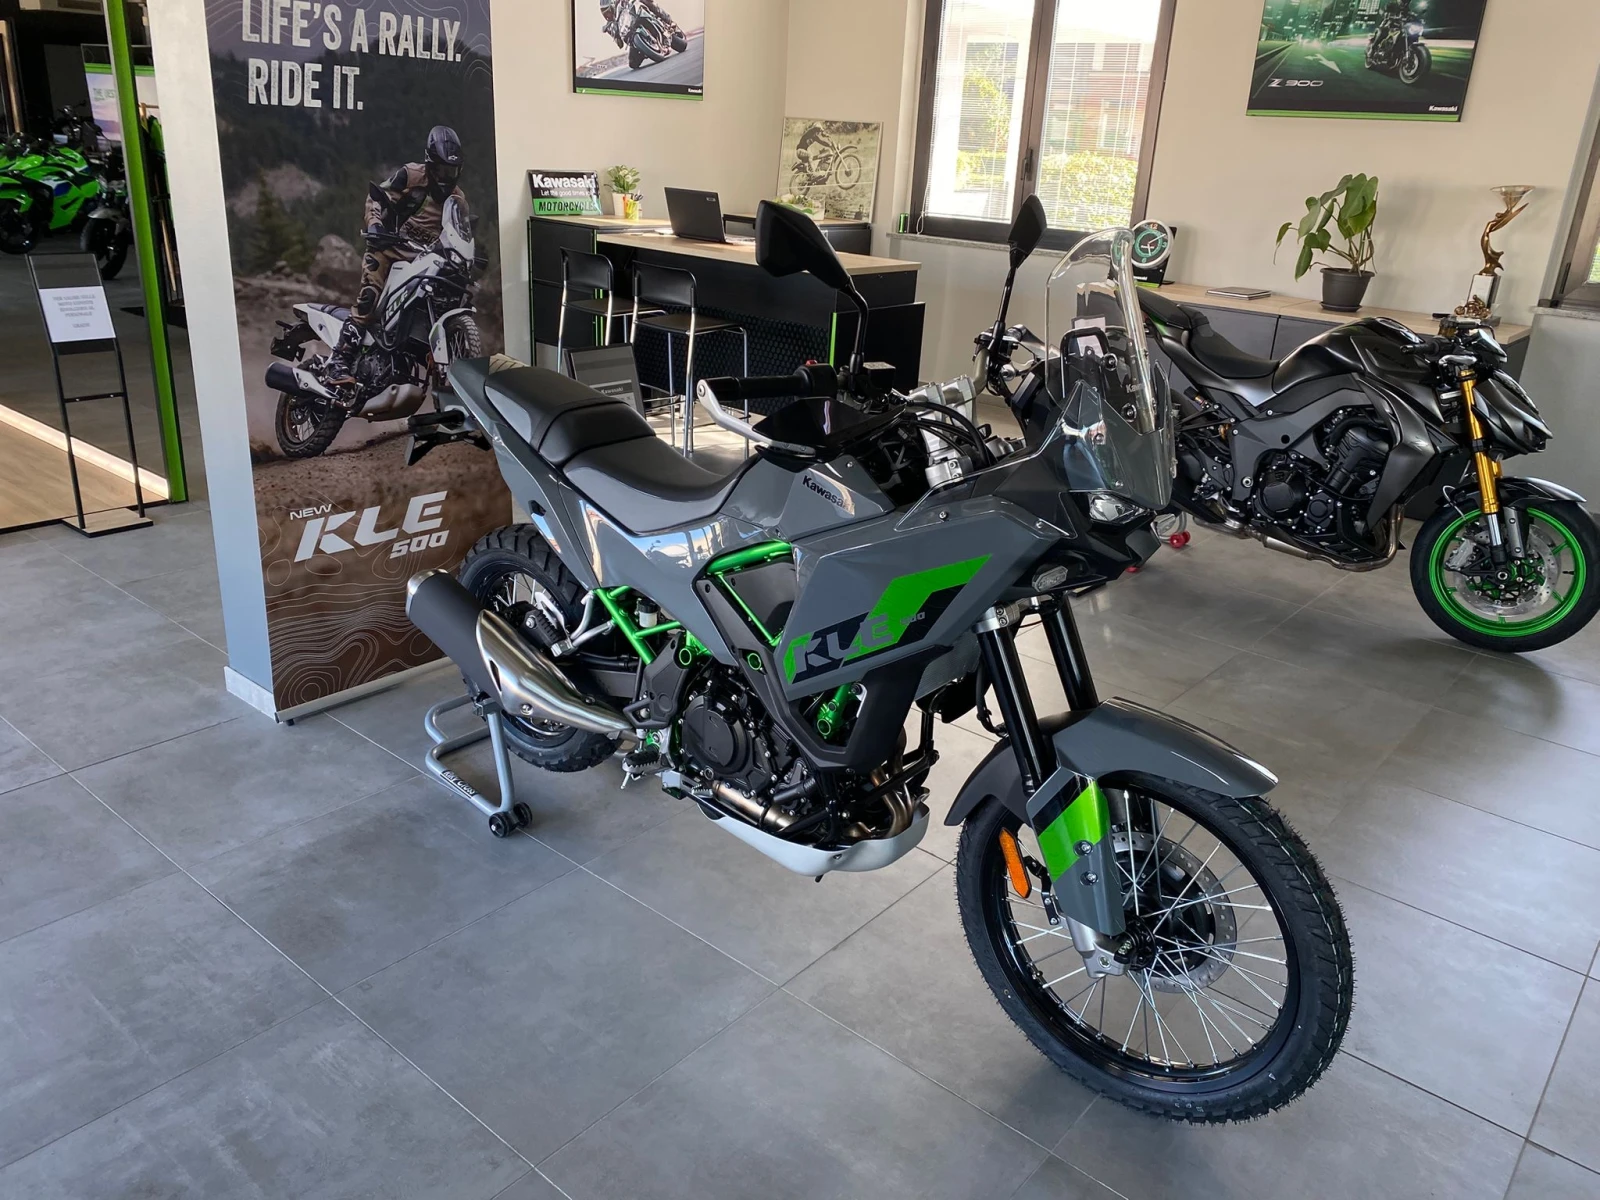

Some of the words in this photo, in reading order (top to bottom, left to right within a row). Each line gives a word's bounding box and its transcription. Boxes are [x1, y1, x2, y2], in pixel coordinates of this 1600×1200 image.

[350, 8, 369, 53] A
[378, 11, 461, 62] RALLY.
[248, 58, 322, 108] RIDE
[333, 65, 363, 110] IT.
[1285, 79, 1324, 87] 900
[532, 173, 597, 188] Kawasaki
[289, 503, 333, 521] NEW
[802, 475, 855, 515] Kawasa
[294, 490, 448, 563] KLE
[389, 529, 450, 560] 500
[793, 613, 895, 673] KLE
